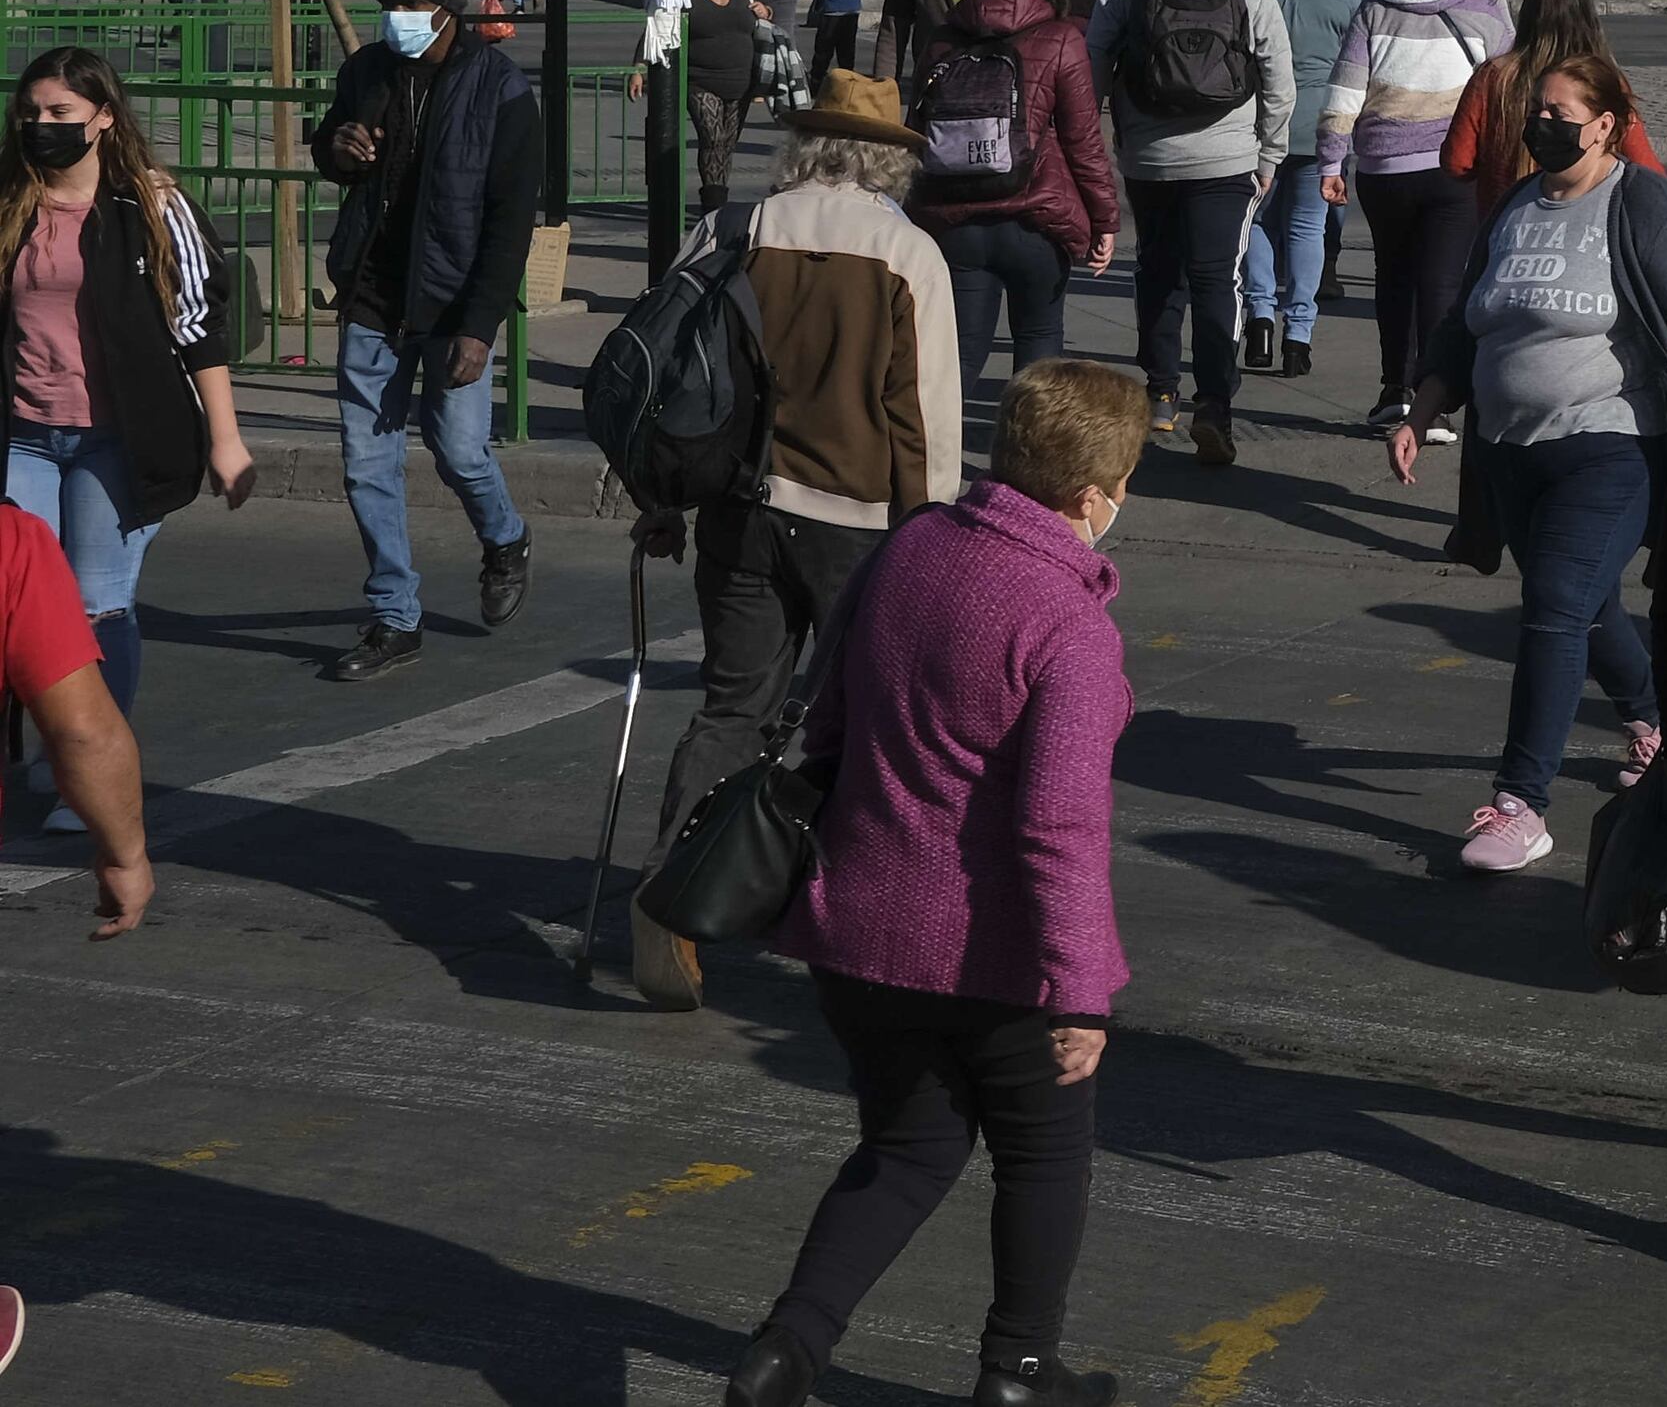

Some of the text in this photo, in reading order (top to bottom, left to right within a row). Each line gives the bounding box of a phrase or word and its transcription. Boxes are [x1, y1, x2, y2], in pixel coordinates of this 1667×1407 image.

[968, 139, 997, 152] EVER
[968, 152, 998, 165] LAST
[1500, 258, 1558, 278] 1610
